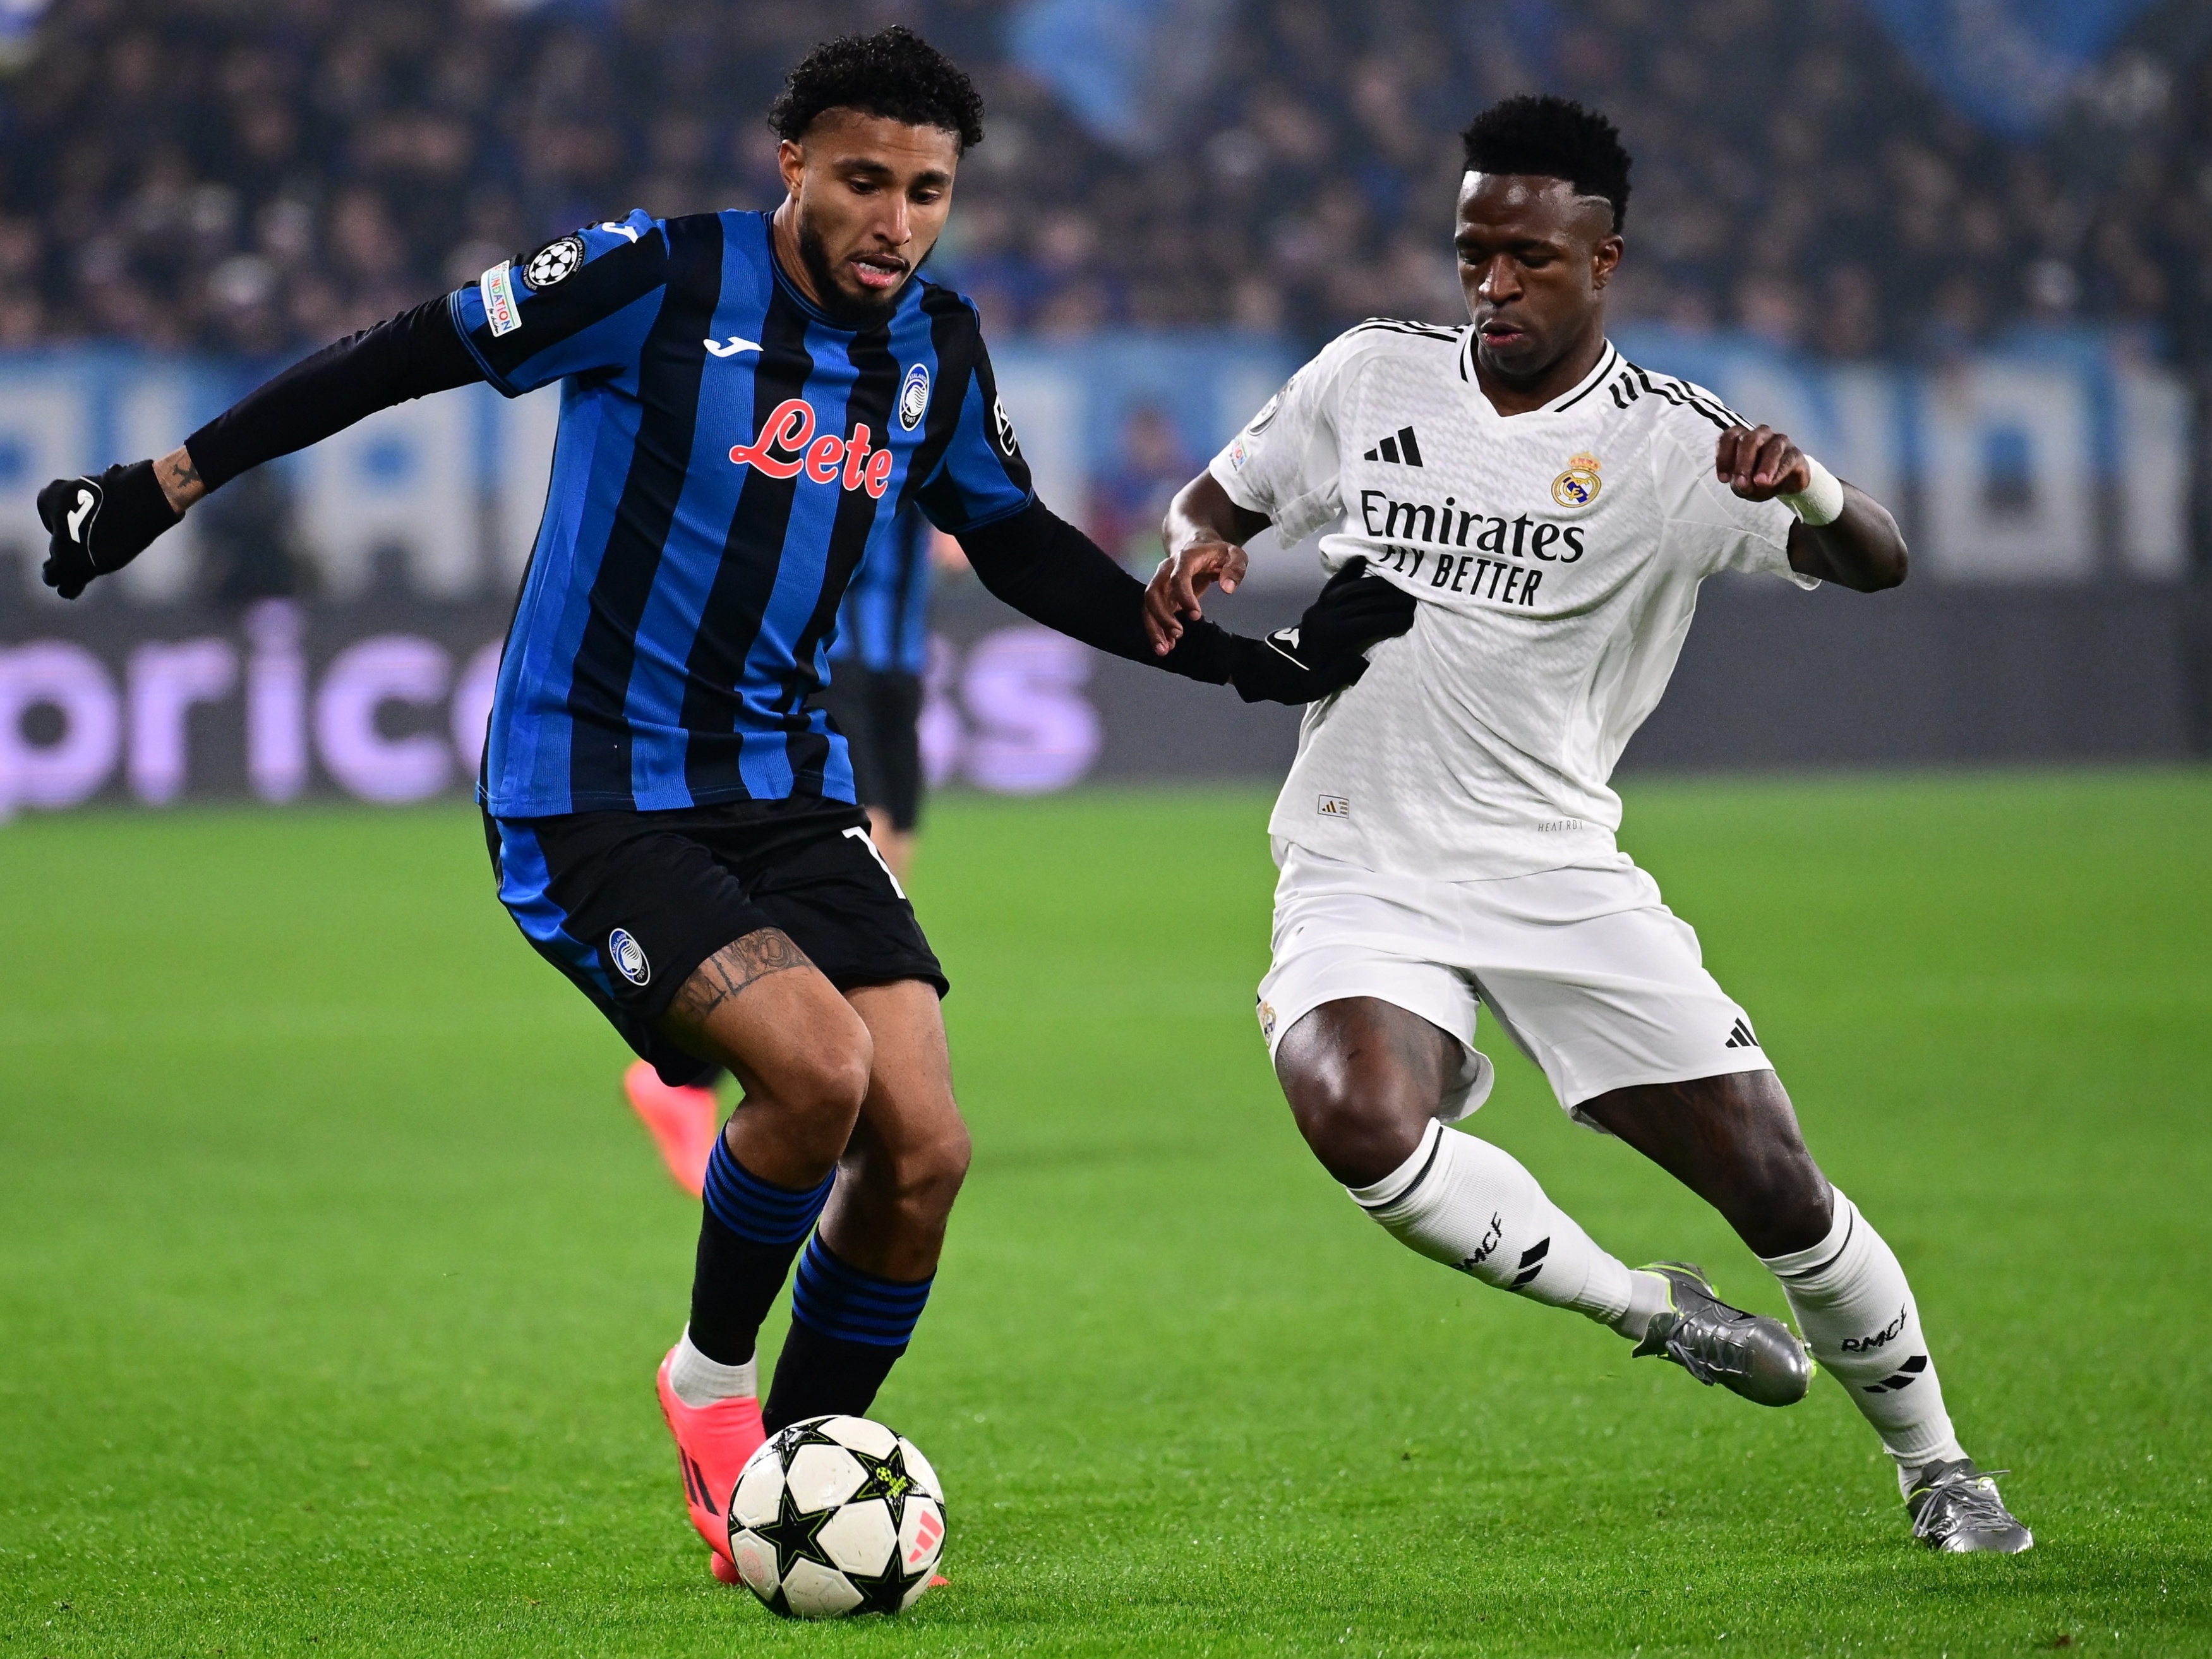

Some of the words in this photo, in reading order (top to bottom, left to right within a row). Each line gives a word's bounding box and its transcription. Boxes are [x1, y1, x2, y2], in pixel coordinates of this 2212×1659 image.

[572, 251, 584, 273] LEAGUE
[904, 414, 917, 424] 1907
[729, 398, 893, 498] Lete
[1361, 490, 1585, 564] Emirates
[1431, 553, 1543, 606] BETTER
[636, 965, 647, 980] 1907
[1841, 1302, 1908, 1353] RMCF
